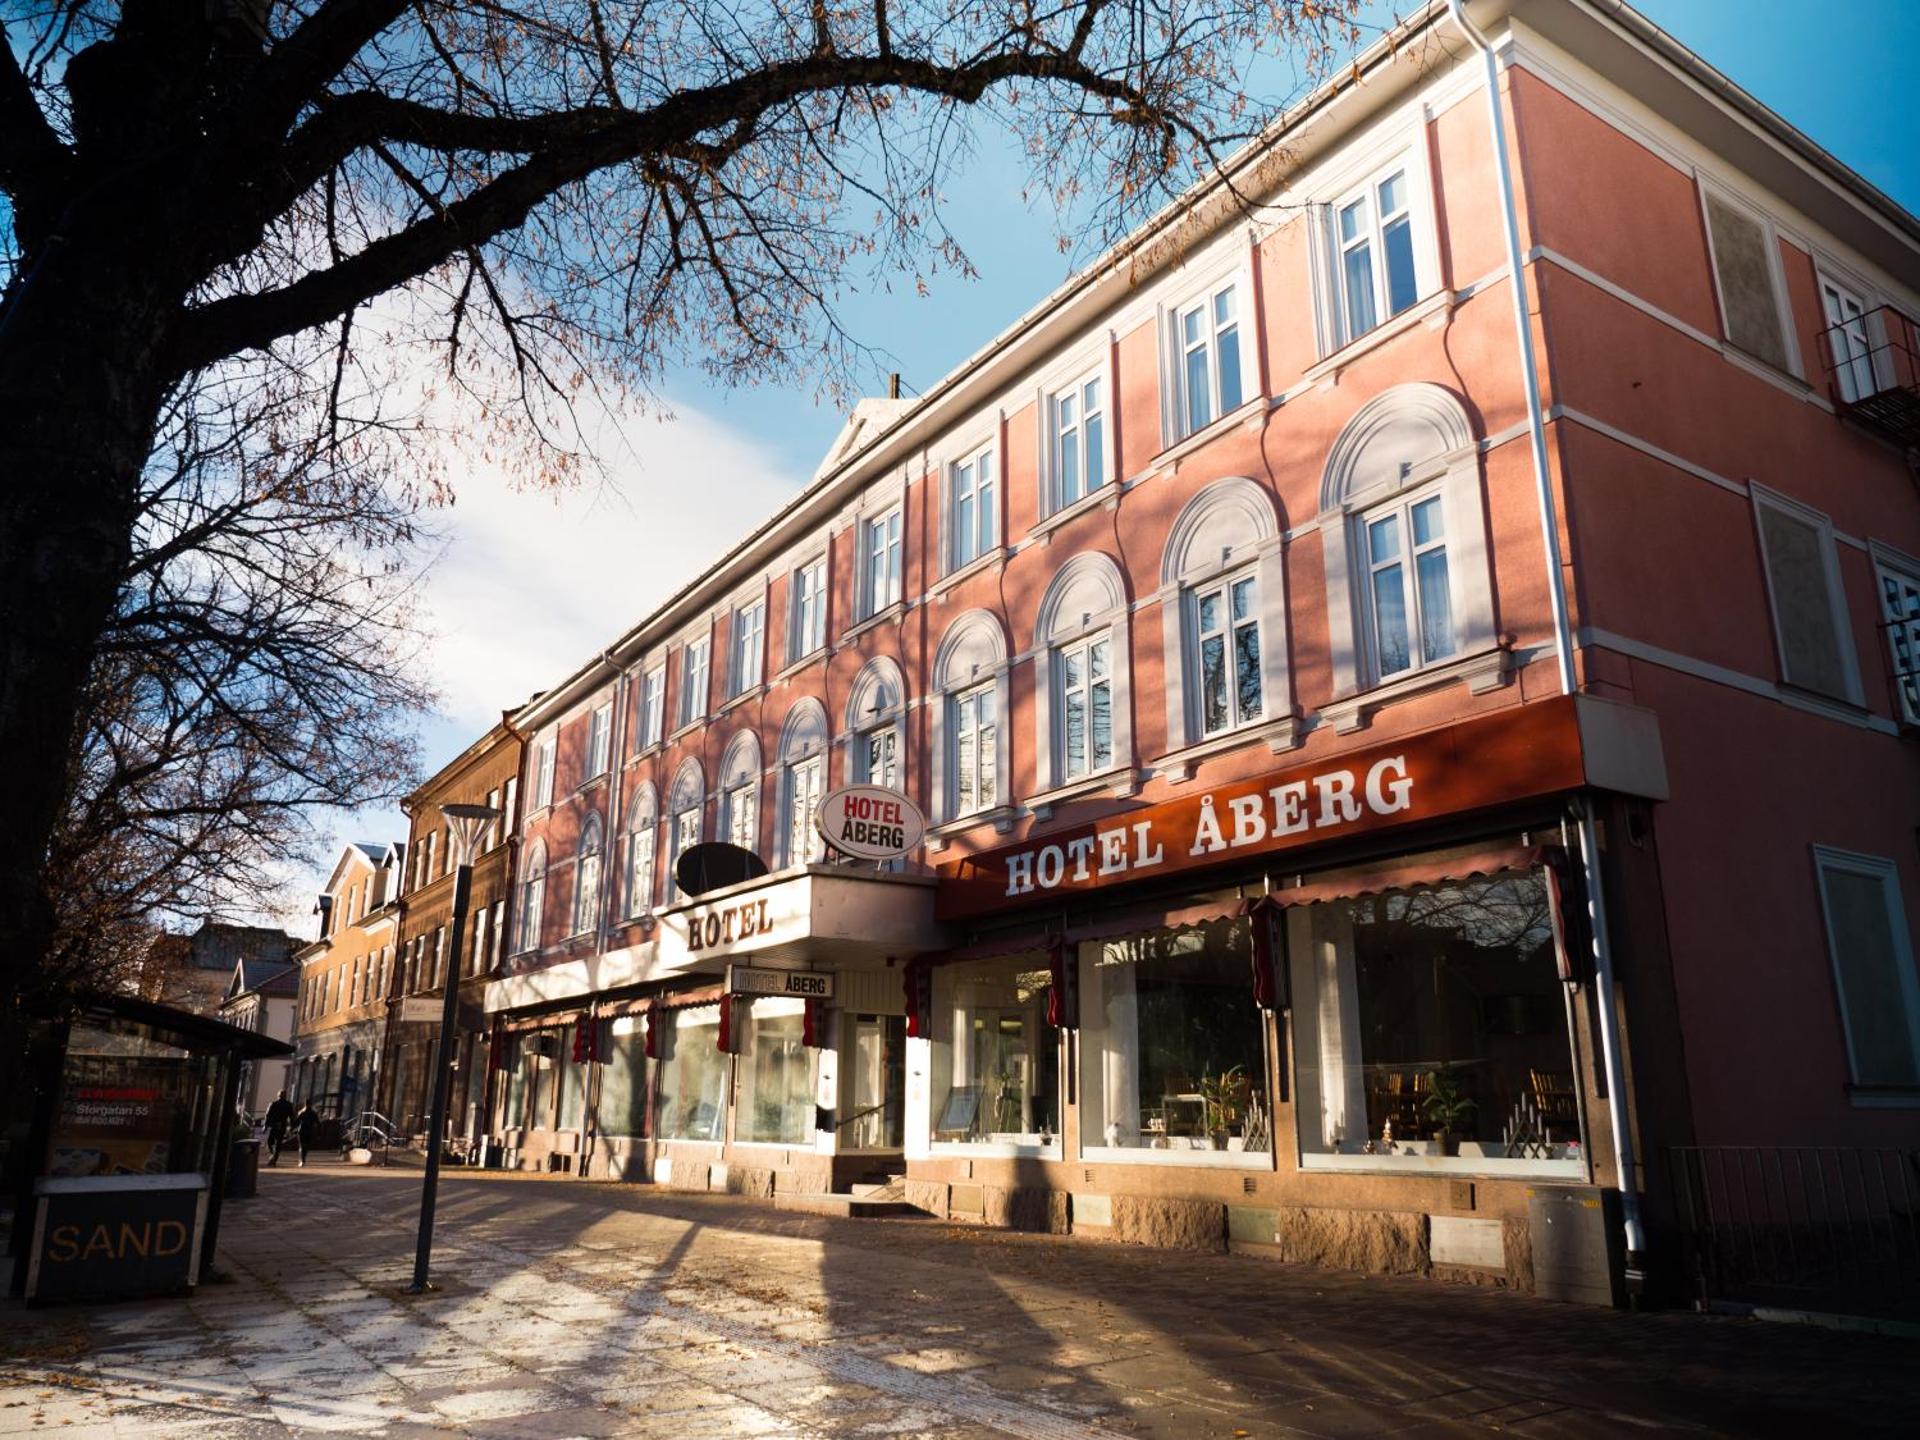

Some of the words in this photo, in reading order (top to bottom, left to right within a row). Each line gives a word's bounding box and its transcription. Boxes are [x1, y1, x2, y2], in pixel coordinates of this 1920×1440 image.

[844, 795, 904, 824] HOTEL
[1005, 820, 1163, 897] HOTEL
[1189, 754, 1414, 857] ÅBERG
[841, 814, 904, 849] ÅBERG
[687, 898, 773, 952] HOTEL
[738, 972, 781, 991] HOTEL
[48, 1220, 187, 1263] SAND
